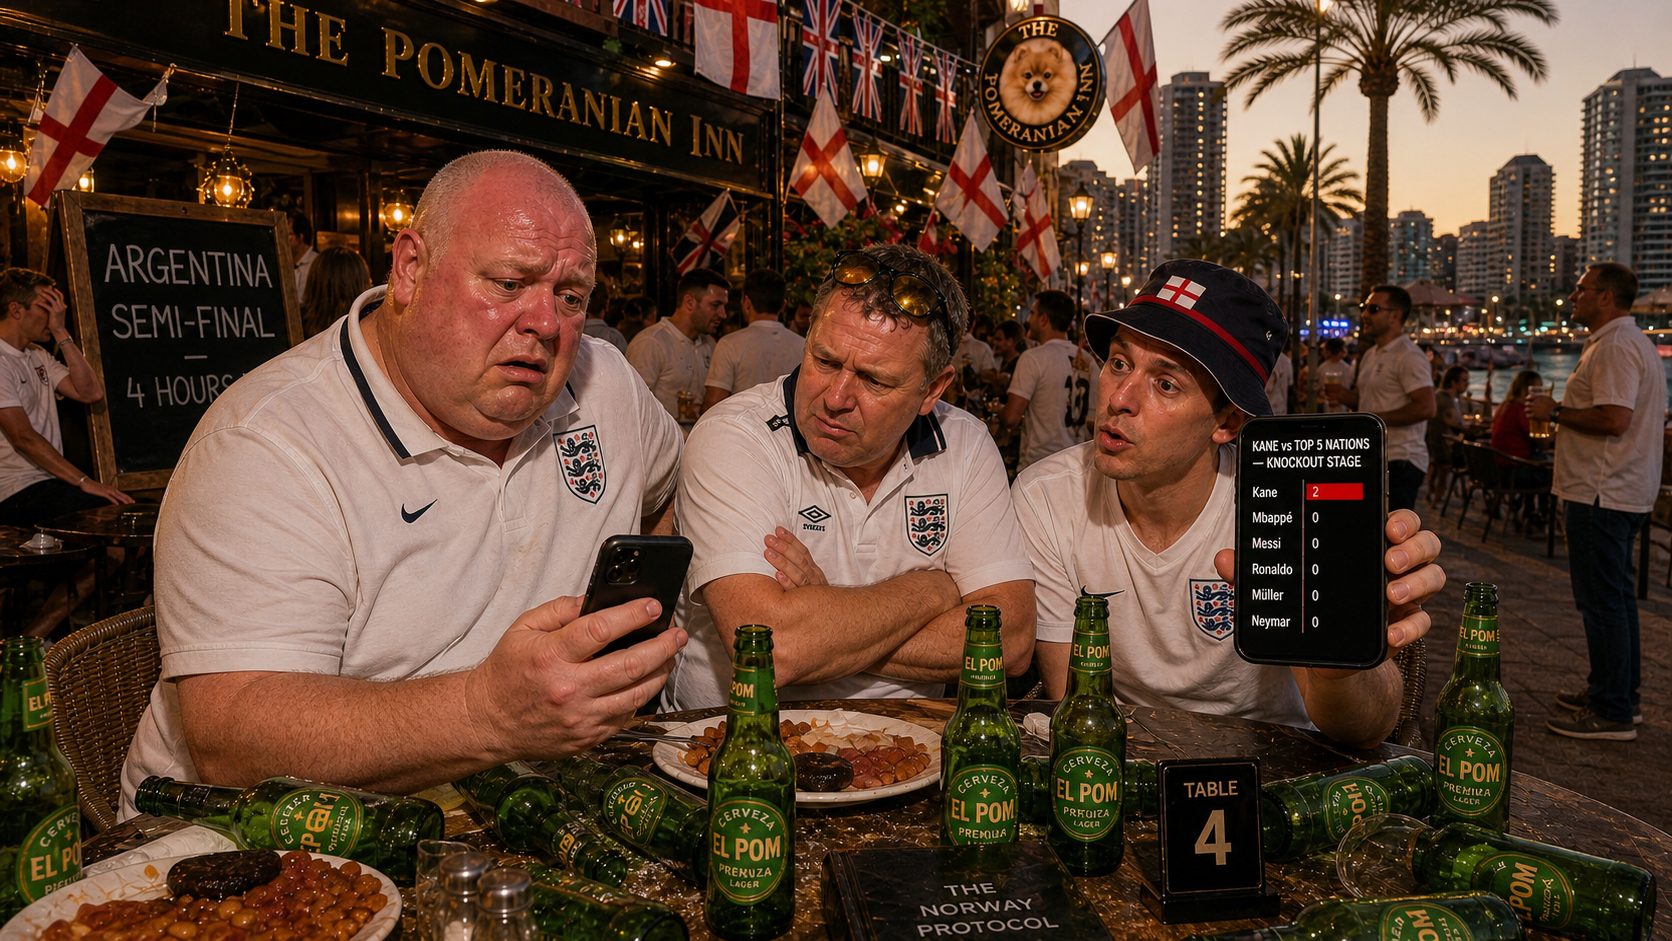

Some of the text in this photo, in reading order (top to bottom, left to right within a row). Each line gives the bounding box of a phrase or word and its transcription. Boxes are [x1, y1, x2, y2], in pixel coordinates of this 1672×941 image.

[1018, 21, 1059, 39] THE
[223, 0, 744, 165] THE POMERANIAN INN
[985, 62, 1094, 142] POMERANIAN INN
[104, 243, 273, 288] ARGENTINA
[111, 303, 275, 339] SEMI-FINAL
[126, 376, 145, 408] 4
[1252, 438, 1370, 452] KANE vs TOP 5 NATIONS
[1266, 456, 1325, 468] KNOCKOUT
[1327, 455, 1362, 468] STAGE
[1252, 485, 1319, 498] Kane 2
[1252, 511, 1319, 526] Mbappé 0
[1252, 537, 1319, 549] Messi 0
[1252, 563, 1319, 575] Ronaldo 0
[1252, 588, 1319, 602] Müller 0
[1251, 614, 1319, 630] Neymar 0
[1470, 628, 1495, 642] POM
[1073, 643, 1110, 659] EL POM
[965, 656, 1004, 672] EL POM
[1444, 735, 1496, 758] CERVEZA
[1063, 755, 1113, 777] CERVEZA
[1439, 754, 1500, 783] EL POM
[957, 775, 1011, 795] CERVEZA
[1057, 778, 1118, 804] EL POM
[1183, 780, 1239, 798] TABLE
[718, 807, 776, 831] CERVEZA
[951, 798, 1015, 824] EL POM
[712, 831, 781, 862] EL POM
[1194, 809, 1232, 866] 4
[30, 854, 58, 881] EL
[943, 882, 997, 897] THE
[1509, 861, 1538, 912] POM
[919, 898, 1032, 917] NORWAY
[916, 917, 1060, 938] PROTOCOL
